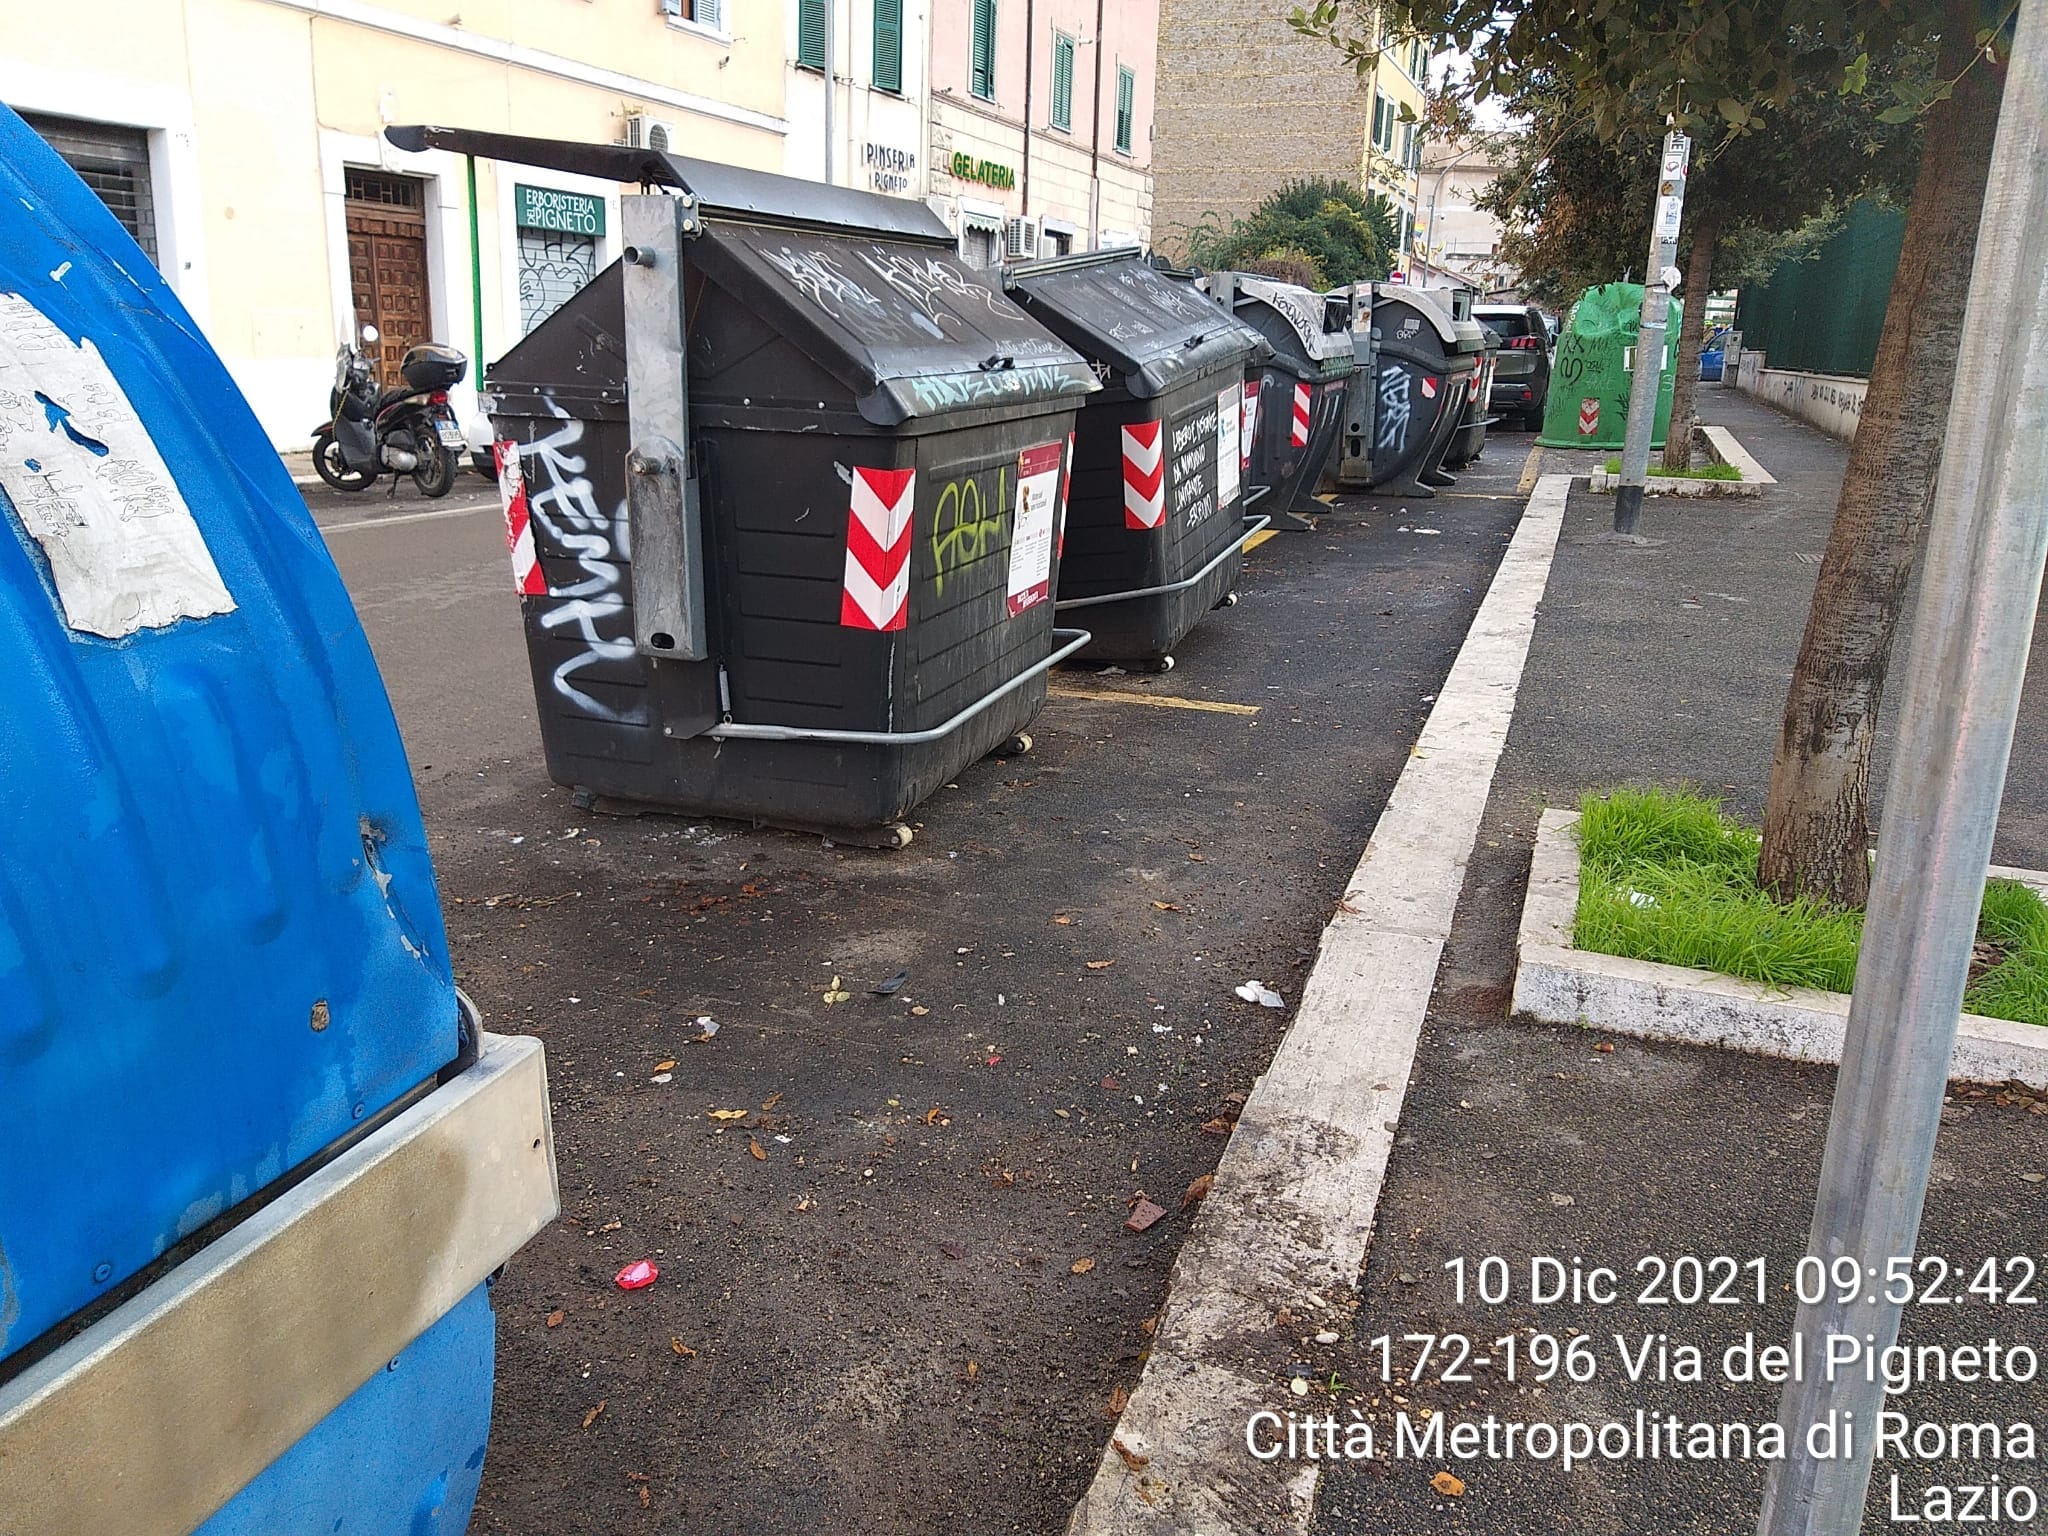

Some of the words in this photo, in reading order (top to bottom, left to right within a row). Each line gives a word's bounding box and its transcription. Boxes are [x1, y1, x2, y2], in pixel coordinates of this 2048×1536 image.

[866, 142, 915, 172] PINSERIA
[953, 151, 1016, 190] GELATERIA
[874, 171, 908, 192] PIGNETO
[525, 188, 596, 214] ERBORISTERIA
[535, 206, 596, 233] PIGNETO
